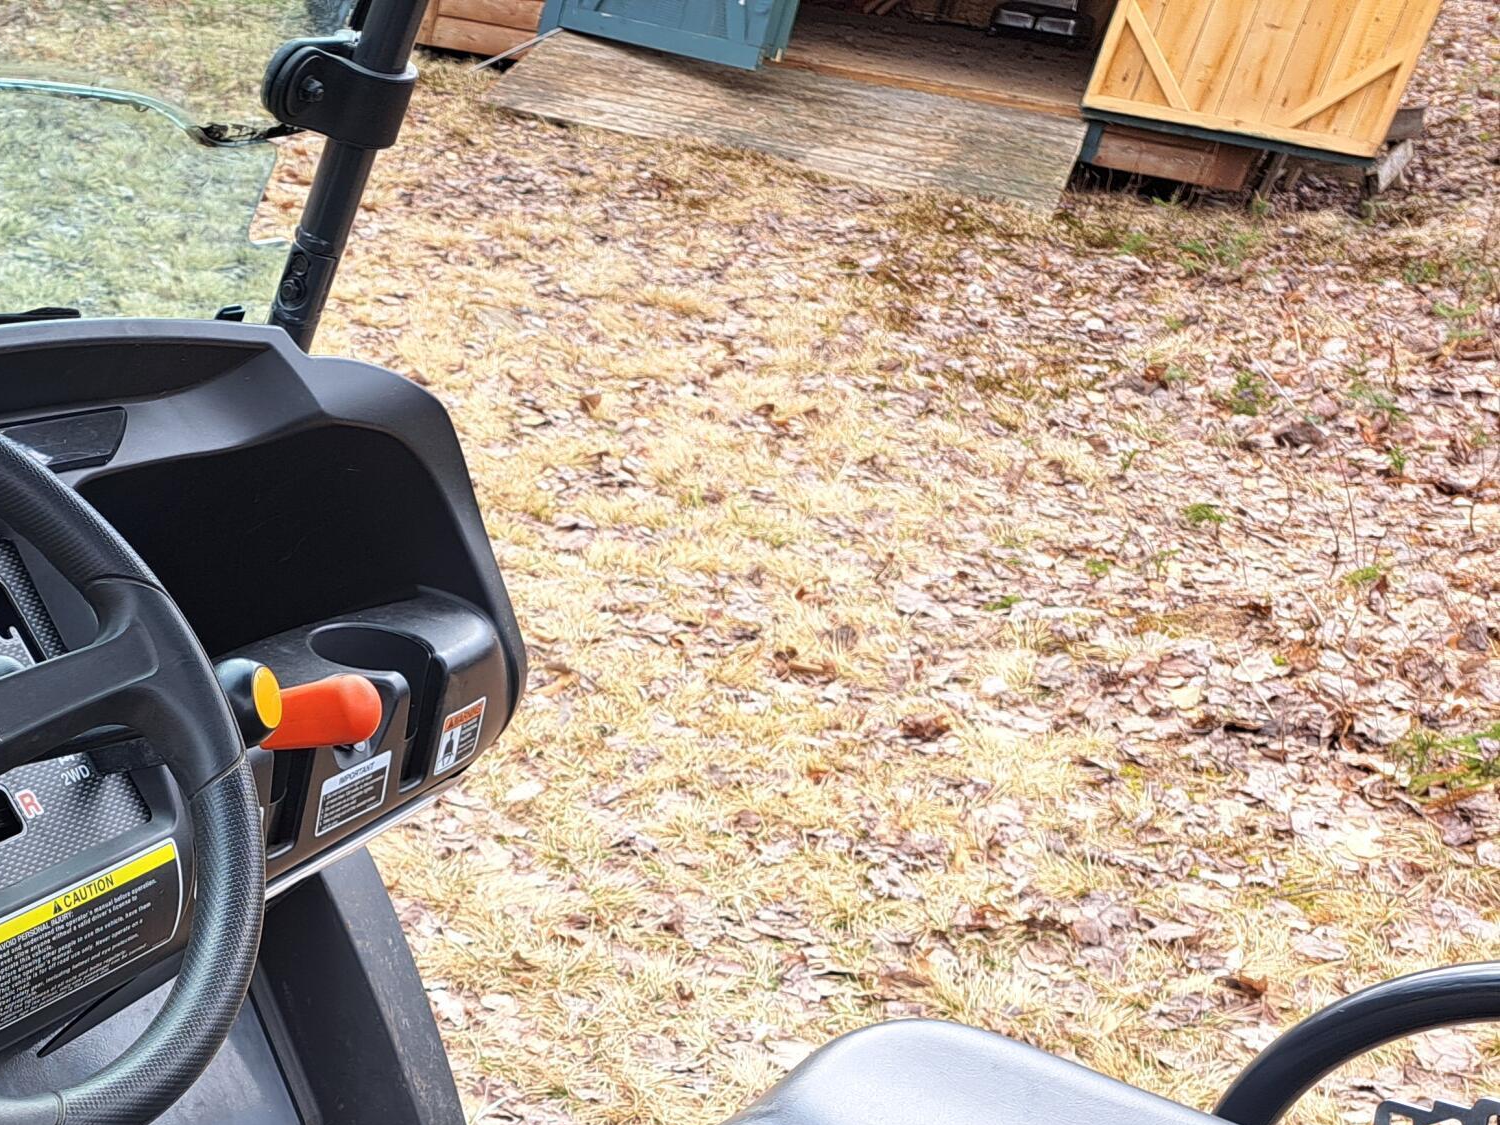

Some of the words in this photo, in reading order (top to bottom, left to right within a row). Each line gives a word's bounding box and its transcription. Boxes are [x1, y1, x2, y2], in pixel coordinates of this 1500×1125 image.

[60, 764, 90, 786] 2WD
[14, 788, 44, 819] R
[63, 875, 113, 907] CAUTION
[11, 943, 21, 953] and
[23, 928, 54, 946] understand
[65, 910, 92, 926] operator's
[94, 899, 113, 912] manual
[114, 891, 130, 902] before
[17, 922, 50, 941] PERSONAL
[50, 911, 73, 925] INJURY:
[14, 949, 28, 959] allow
[30, 938, 50, 951] anyone
[52, 926, 71, 940] without
[77, 917, 90, 928] valid
[19, 955, 30, 963] this
